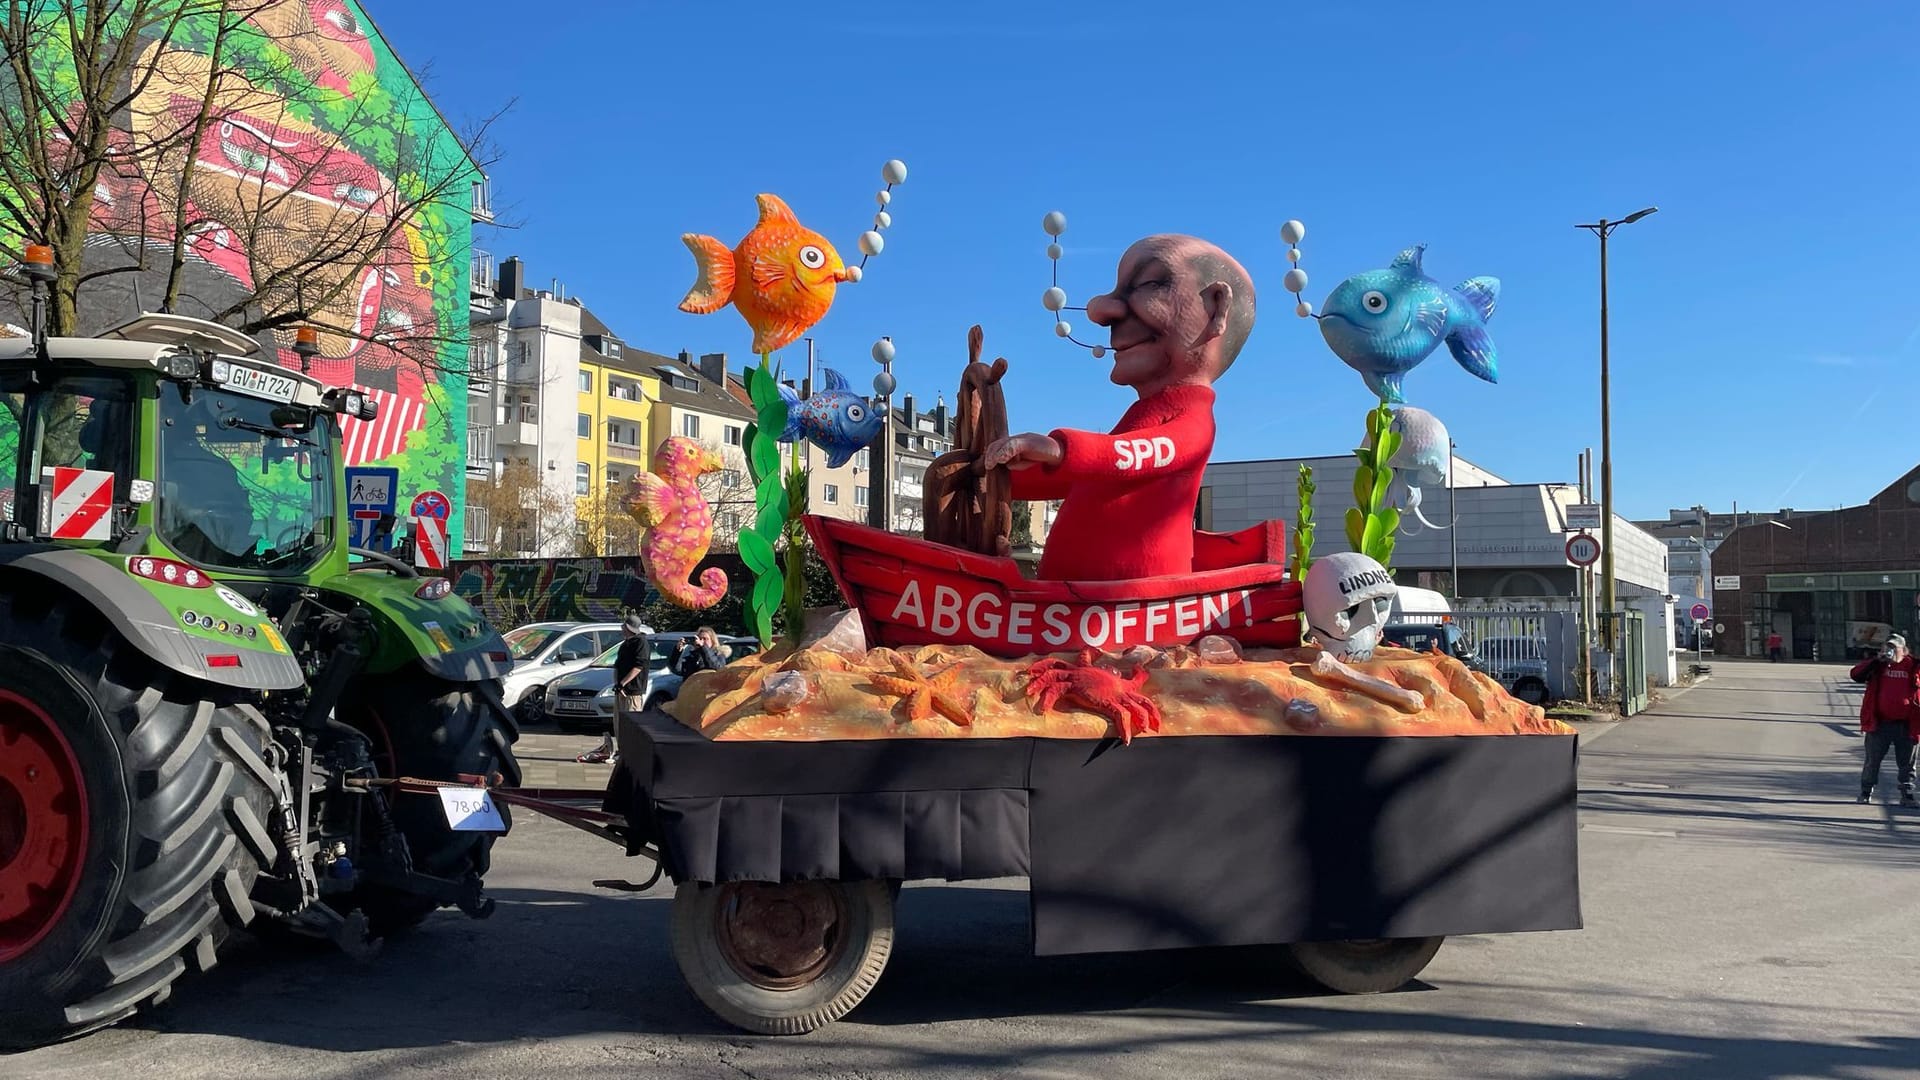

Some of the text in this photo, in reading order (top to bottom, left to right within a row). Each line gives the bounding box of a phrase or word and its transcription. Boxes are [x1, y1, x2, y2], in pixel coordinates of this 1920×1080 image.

[233, 369, 292, 397] GV H 724
[1114, 436, 1176, 470] SPD
